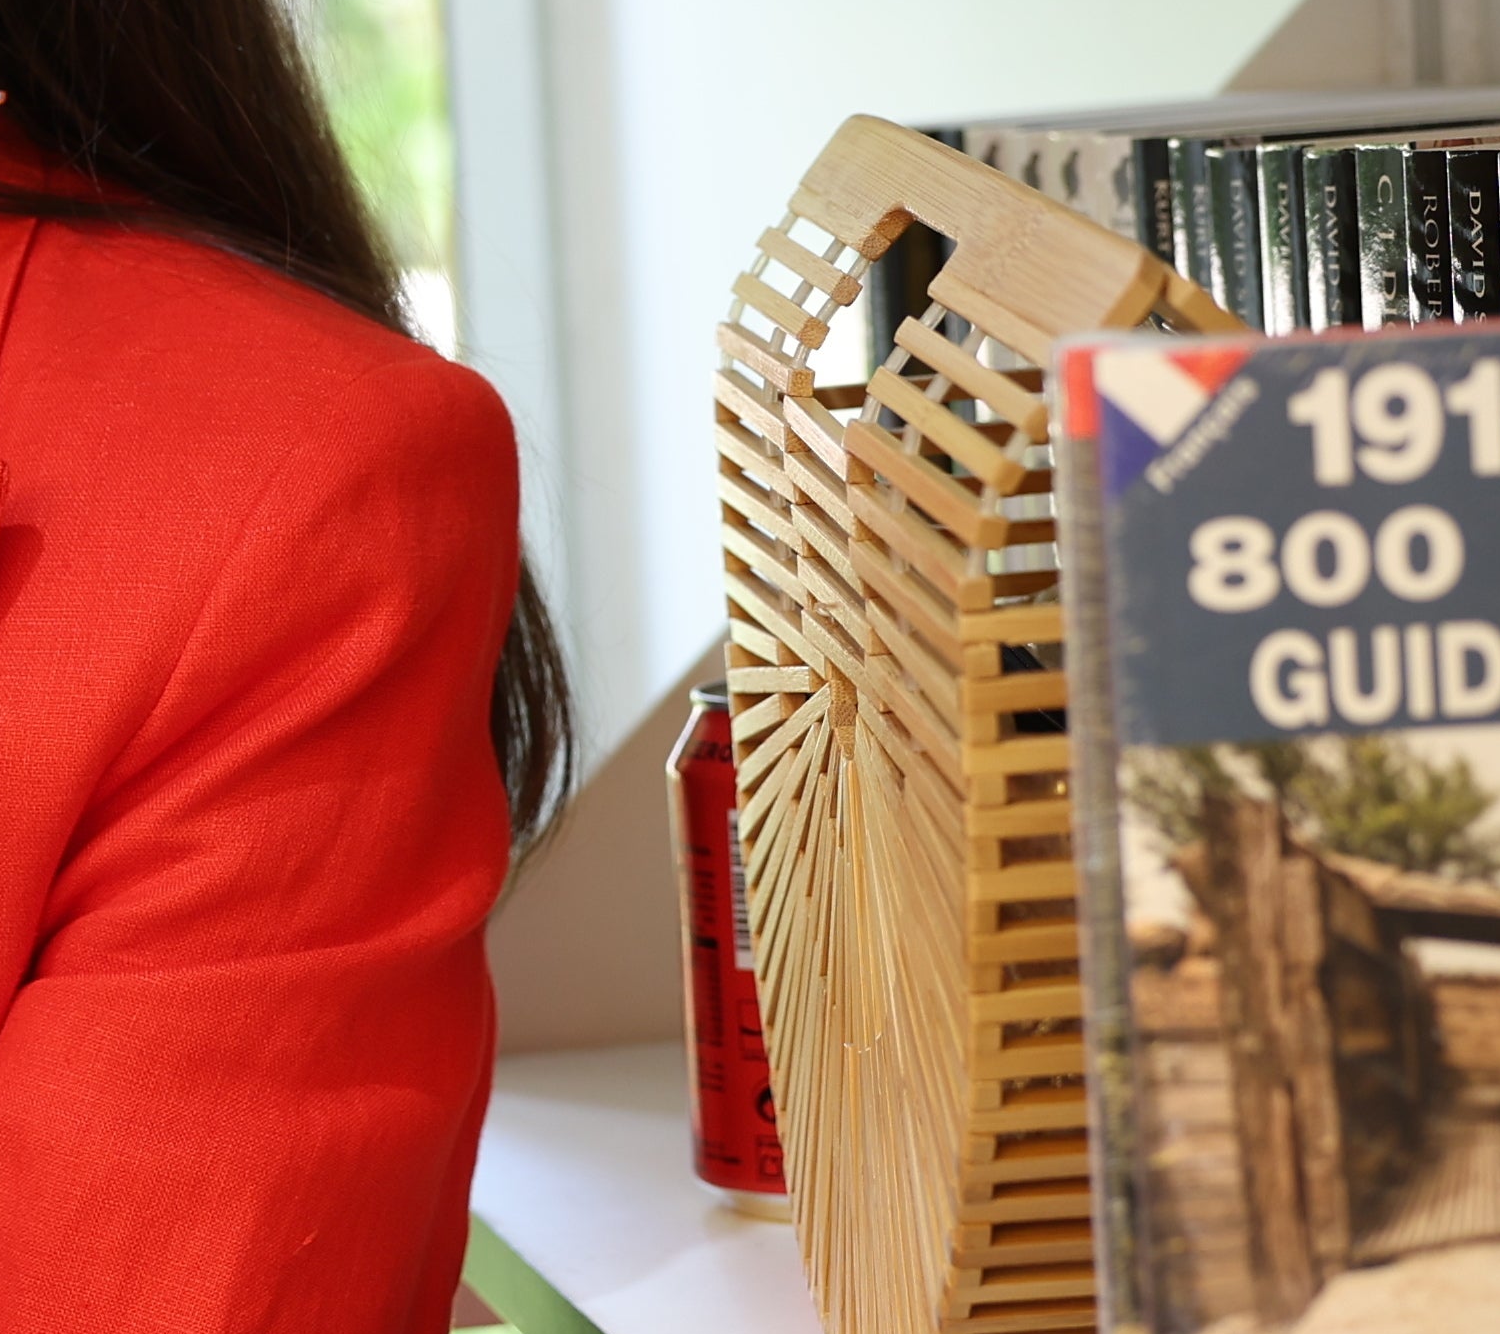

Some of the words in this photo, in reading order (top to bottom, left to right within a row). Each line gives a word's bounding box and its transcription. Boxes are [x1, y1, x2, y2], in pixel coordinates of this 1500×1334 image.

[1323, 184, 1342, 286] DAVID
[1469, 190, 1487, 299] DAVID
[1187, 504, 1466, 614] 800
